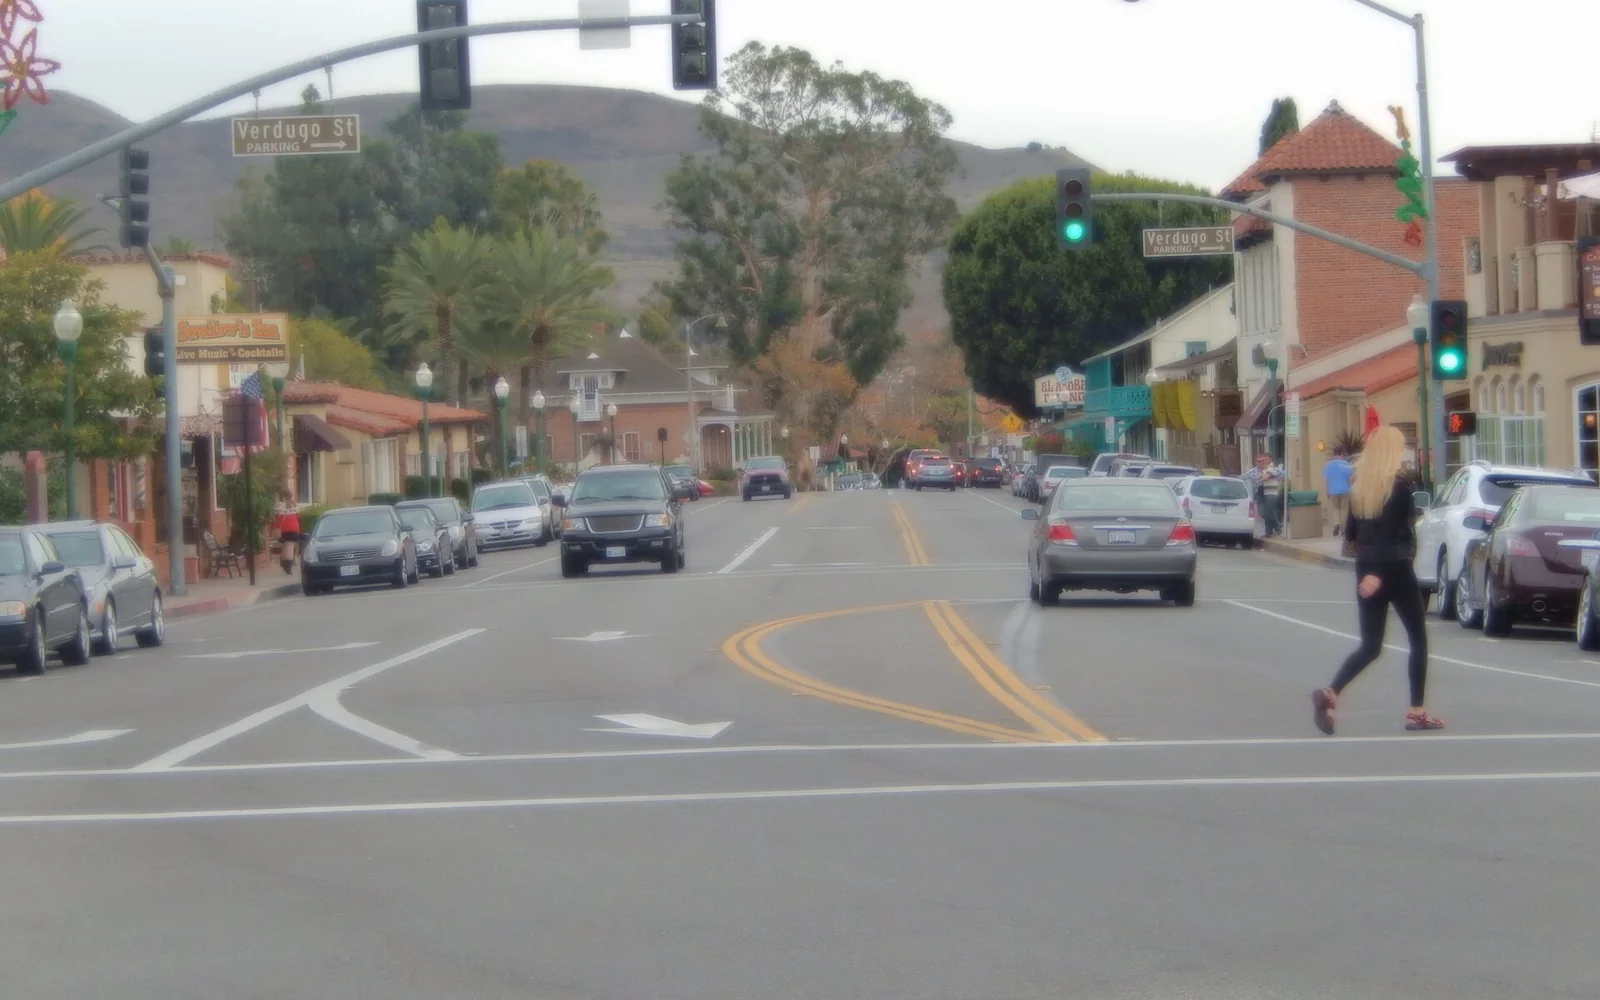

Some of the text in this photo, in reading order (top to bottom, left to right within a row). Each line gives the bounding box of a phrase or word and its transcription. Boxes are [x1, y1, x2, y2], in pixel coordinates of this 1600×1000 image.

[237, 118, 354, 144] Verdugo St
[246, 141, 300, 153] PARKING
[1147, 229, 1231, 248] Verdugo St
[1153, 244, 1193, 254] PARKING
[251, 318, 280, 340] Inn
[176, 349, 196, 359] Live
[199, 348, 229, 359] Music
[238, 347, 285, 358] Cocktails
